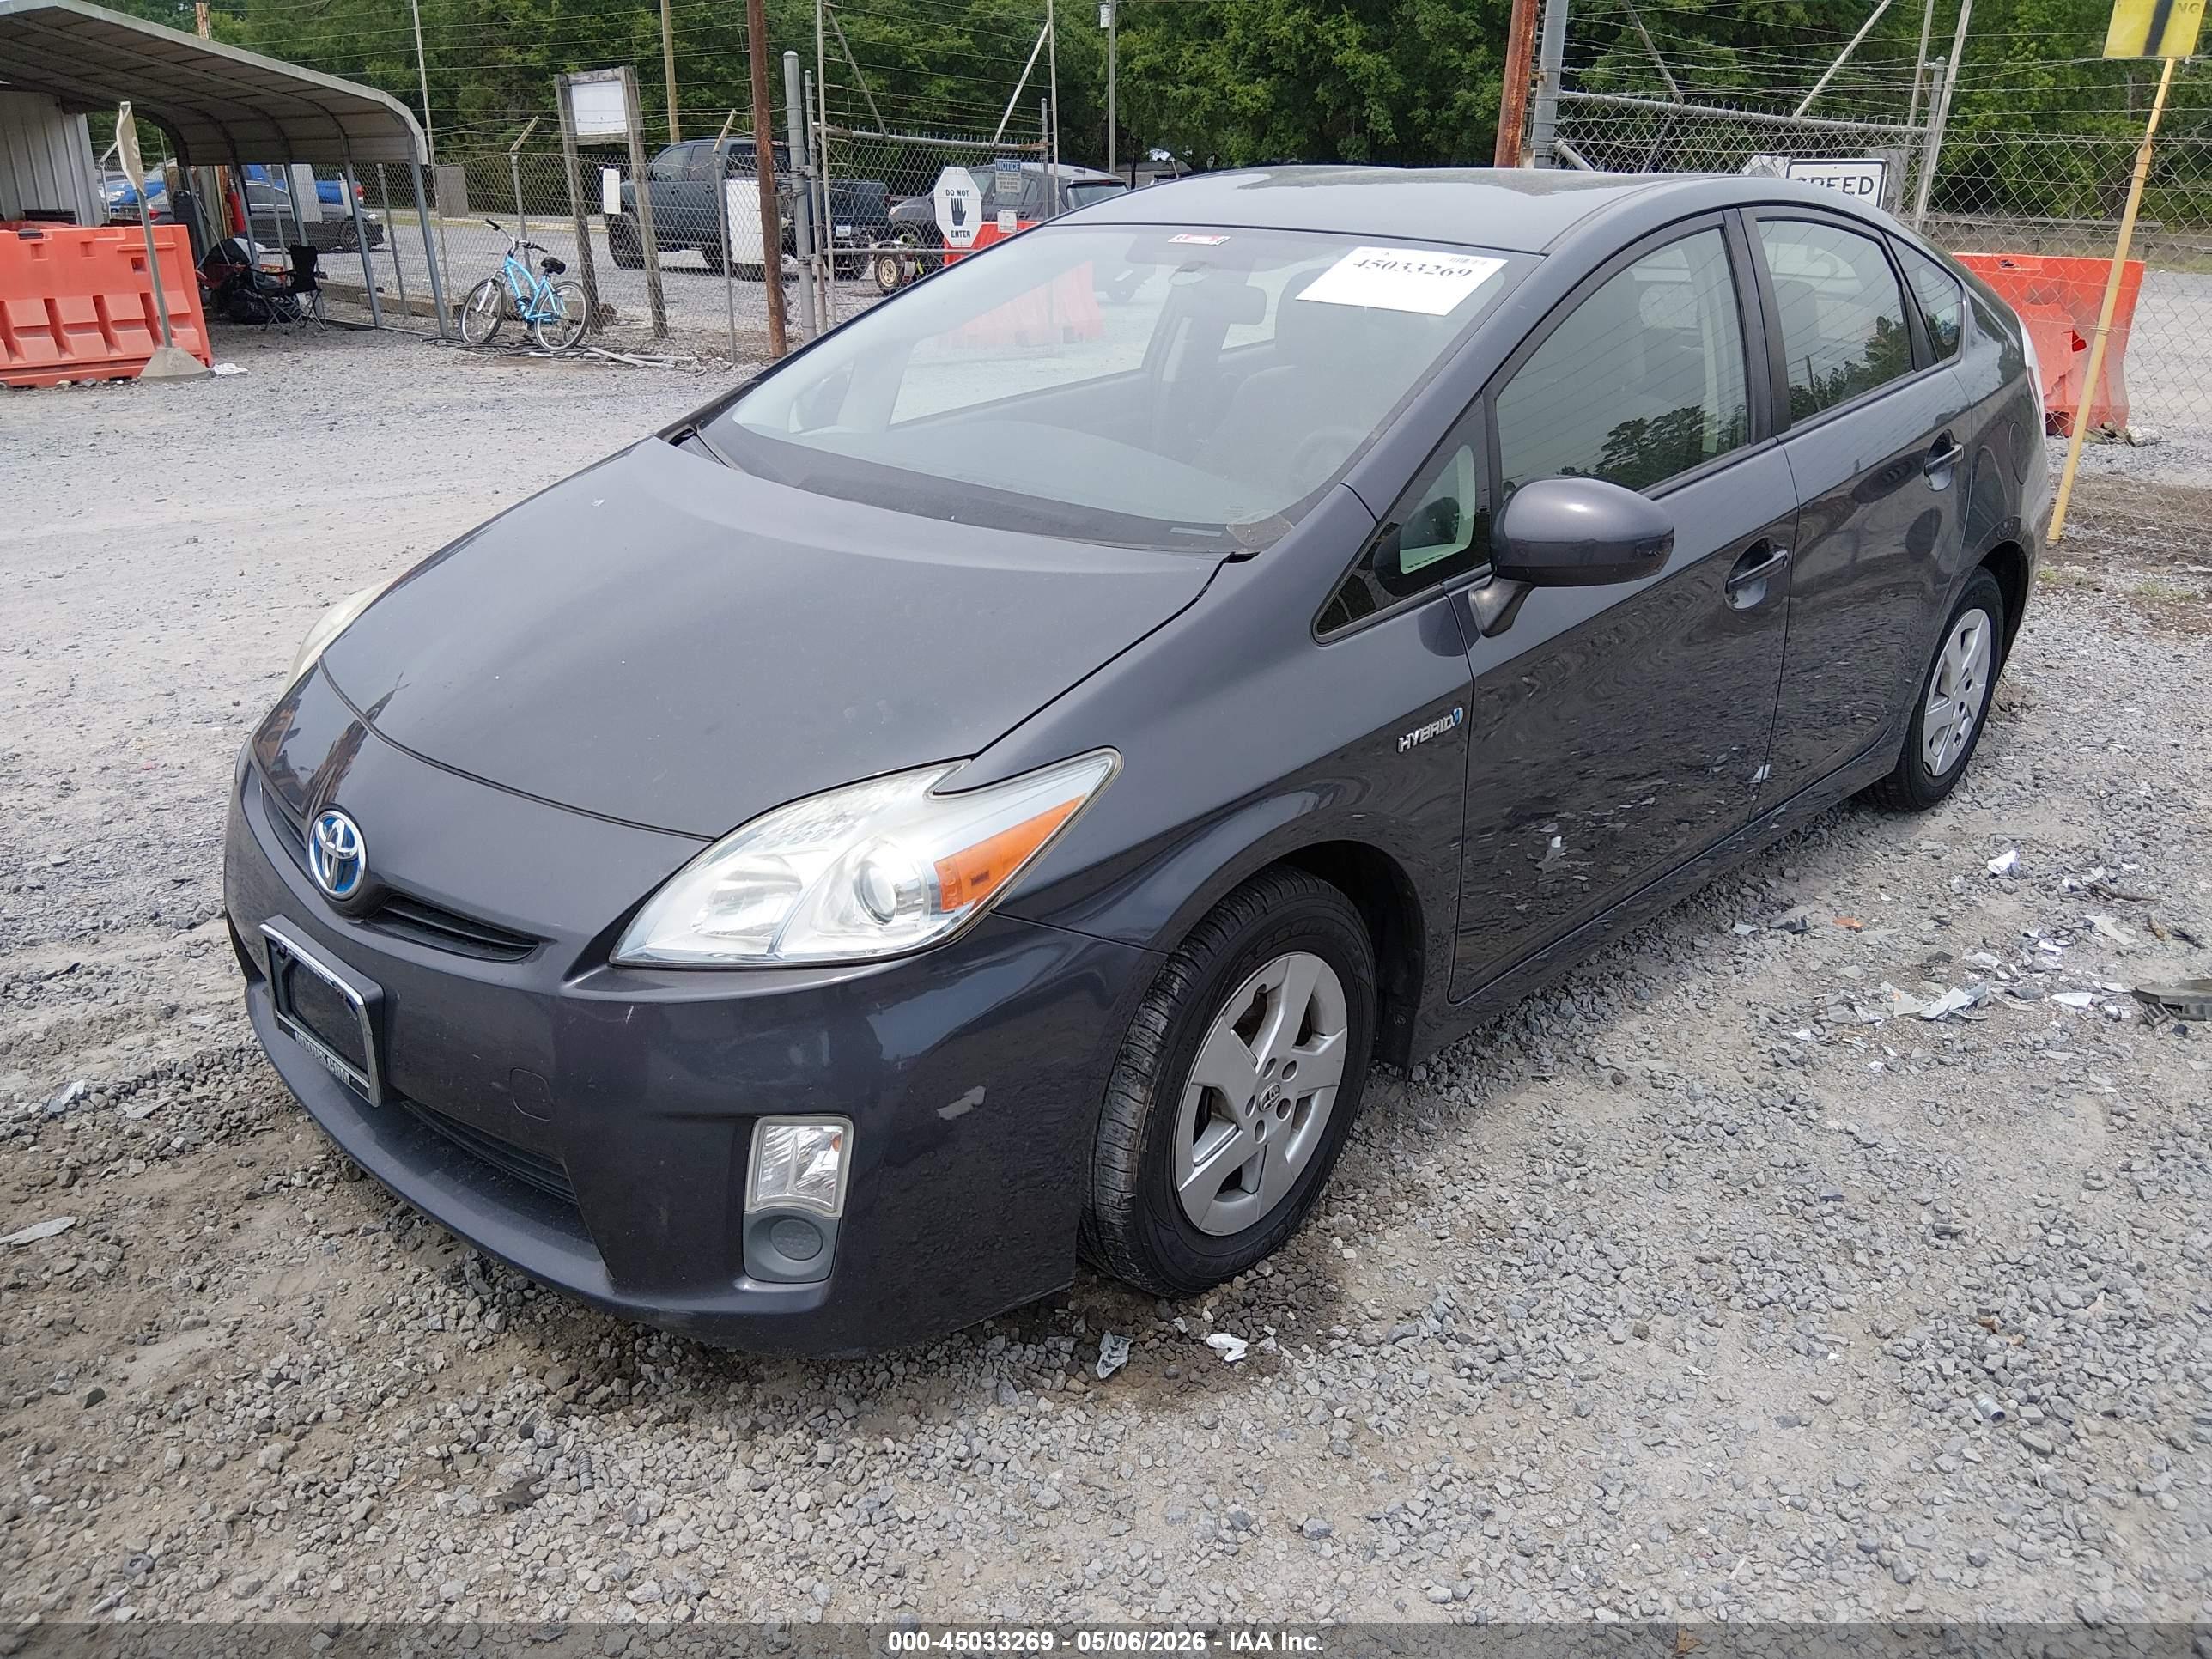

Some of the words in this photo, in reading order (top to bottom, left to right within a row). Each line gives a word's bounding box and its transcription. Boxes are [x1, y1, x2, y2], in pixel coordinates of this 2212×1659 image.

[996, 161, 1020, 172] NOTICE
[1797, 176, 1875, 195] EED
[1353, 258, 1473, 277] 45033269
[1397, 714, 1455, 753] HYBRID
